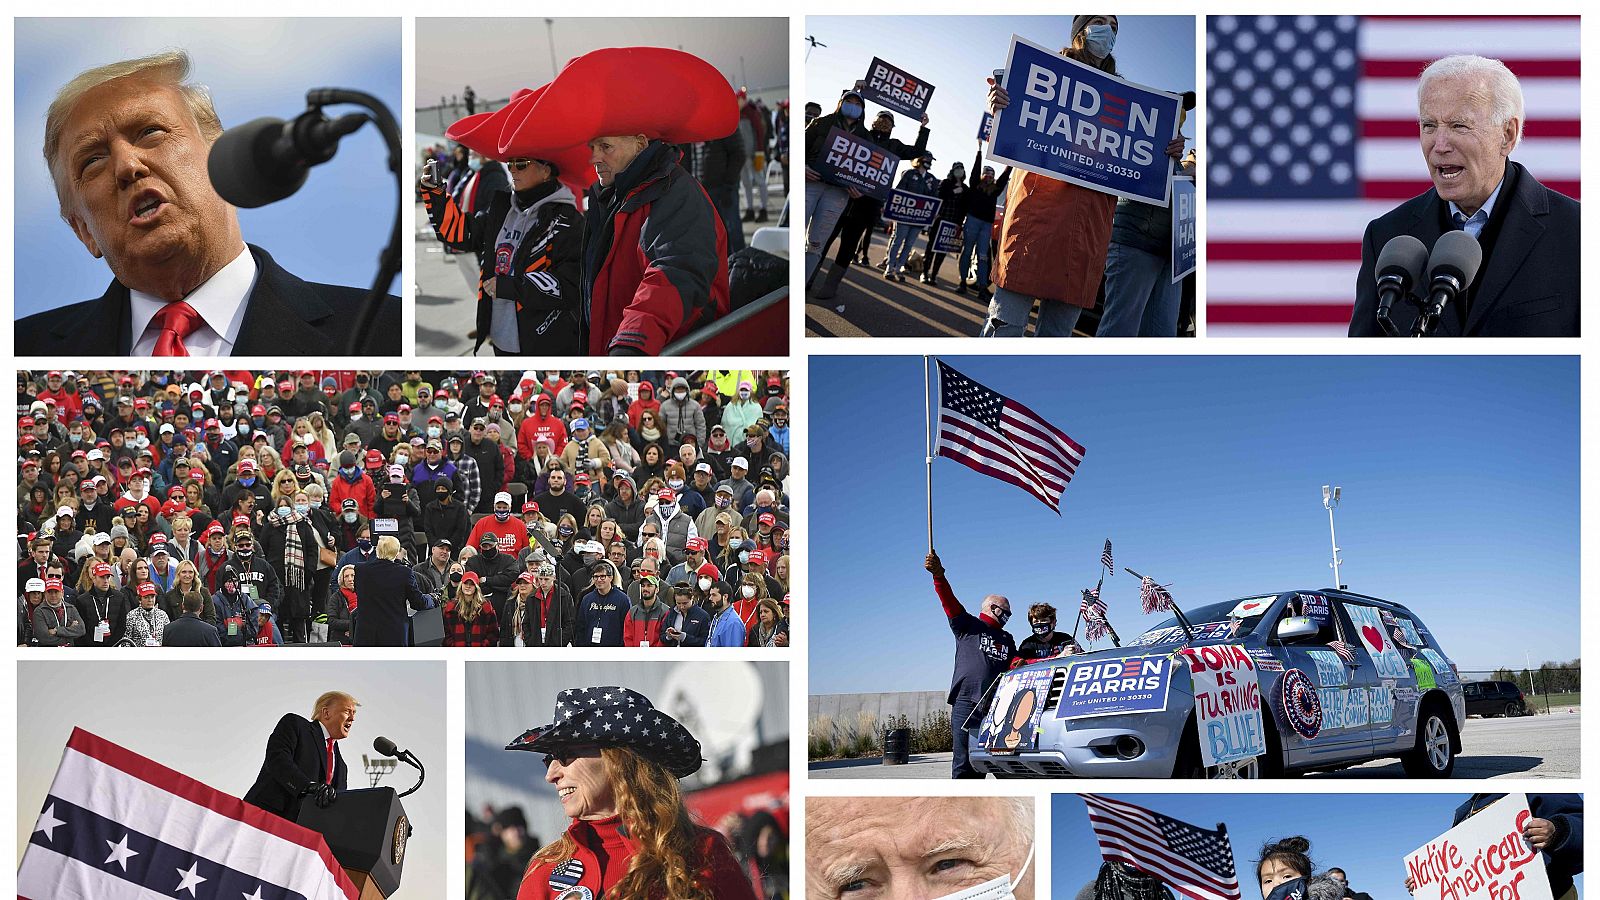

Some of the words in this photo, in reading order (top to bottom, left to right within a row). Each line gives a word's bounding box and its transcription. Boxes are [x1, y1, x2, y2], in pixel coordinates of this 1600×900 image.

[869, 78, 924, 109] HARRIS
[873, 64, 929, 100] BIDEN
[1025, 62, 1159, 138] BIDEN
[1018, 100, 1154, 167] HARRIS
[825, 151, 891, 186] HARRIS
[831, 135, 895, 174] BIDEN
[1026, 138, 1050, 153] Text
[1050, 145, 1094, 167] UNITED
[1095, 159, 1105, 170] to
[1106, 163, 1141, 180] 30330
[835, 171, 876, 190] JoeBiden.com
[889, 203, 932, 218] HARRIS
[1164, 630, 1226, 643] HARIS
[1171, 623, 1231, 637] BDEN
[1073, 659, 1164, 682] BIDEN
[1179, 644, 1254, 673] IOWA
[1069, 676, 1161, 697] HARRIS
[1215, 670, 1237, 687] IS
[1087, 696, 1118, 705] UNITED
[1127, 693, 1153, 701] 30330
[1195, 681, 1260, 720] TURNING
[1347, 688, 1365, 706] ARE
[1369, 687, 1389, 706] JAN
[1321, 708, 1343, 729] DAYS
[1207, 711, 1264, 760] BLUE!
[1409, 840, 1463, 890] Native
[1488, 871, 1526, 900] For
